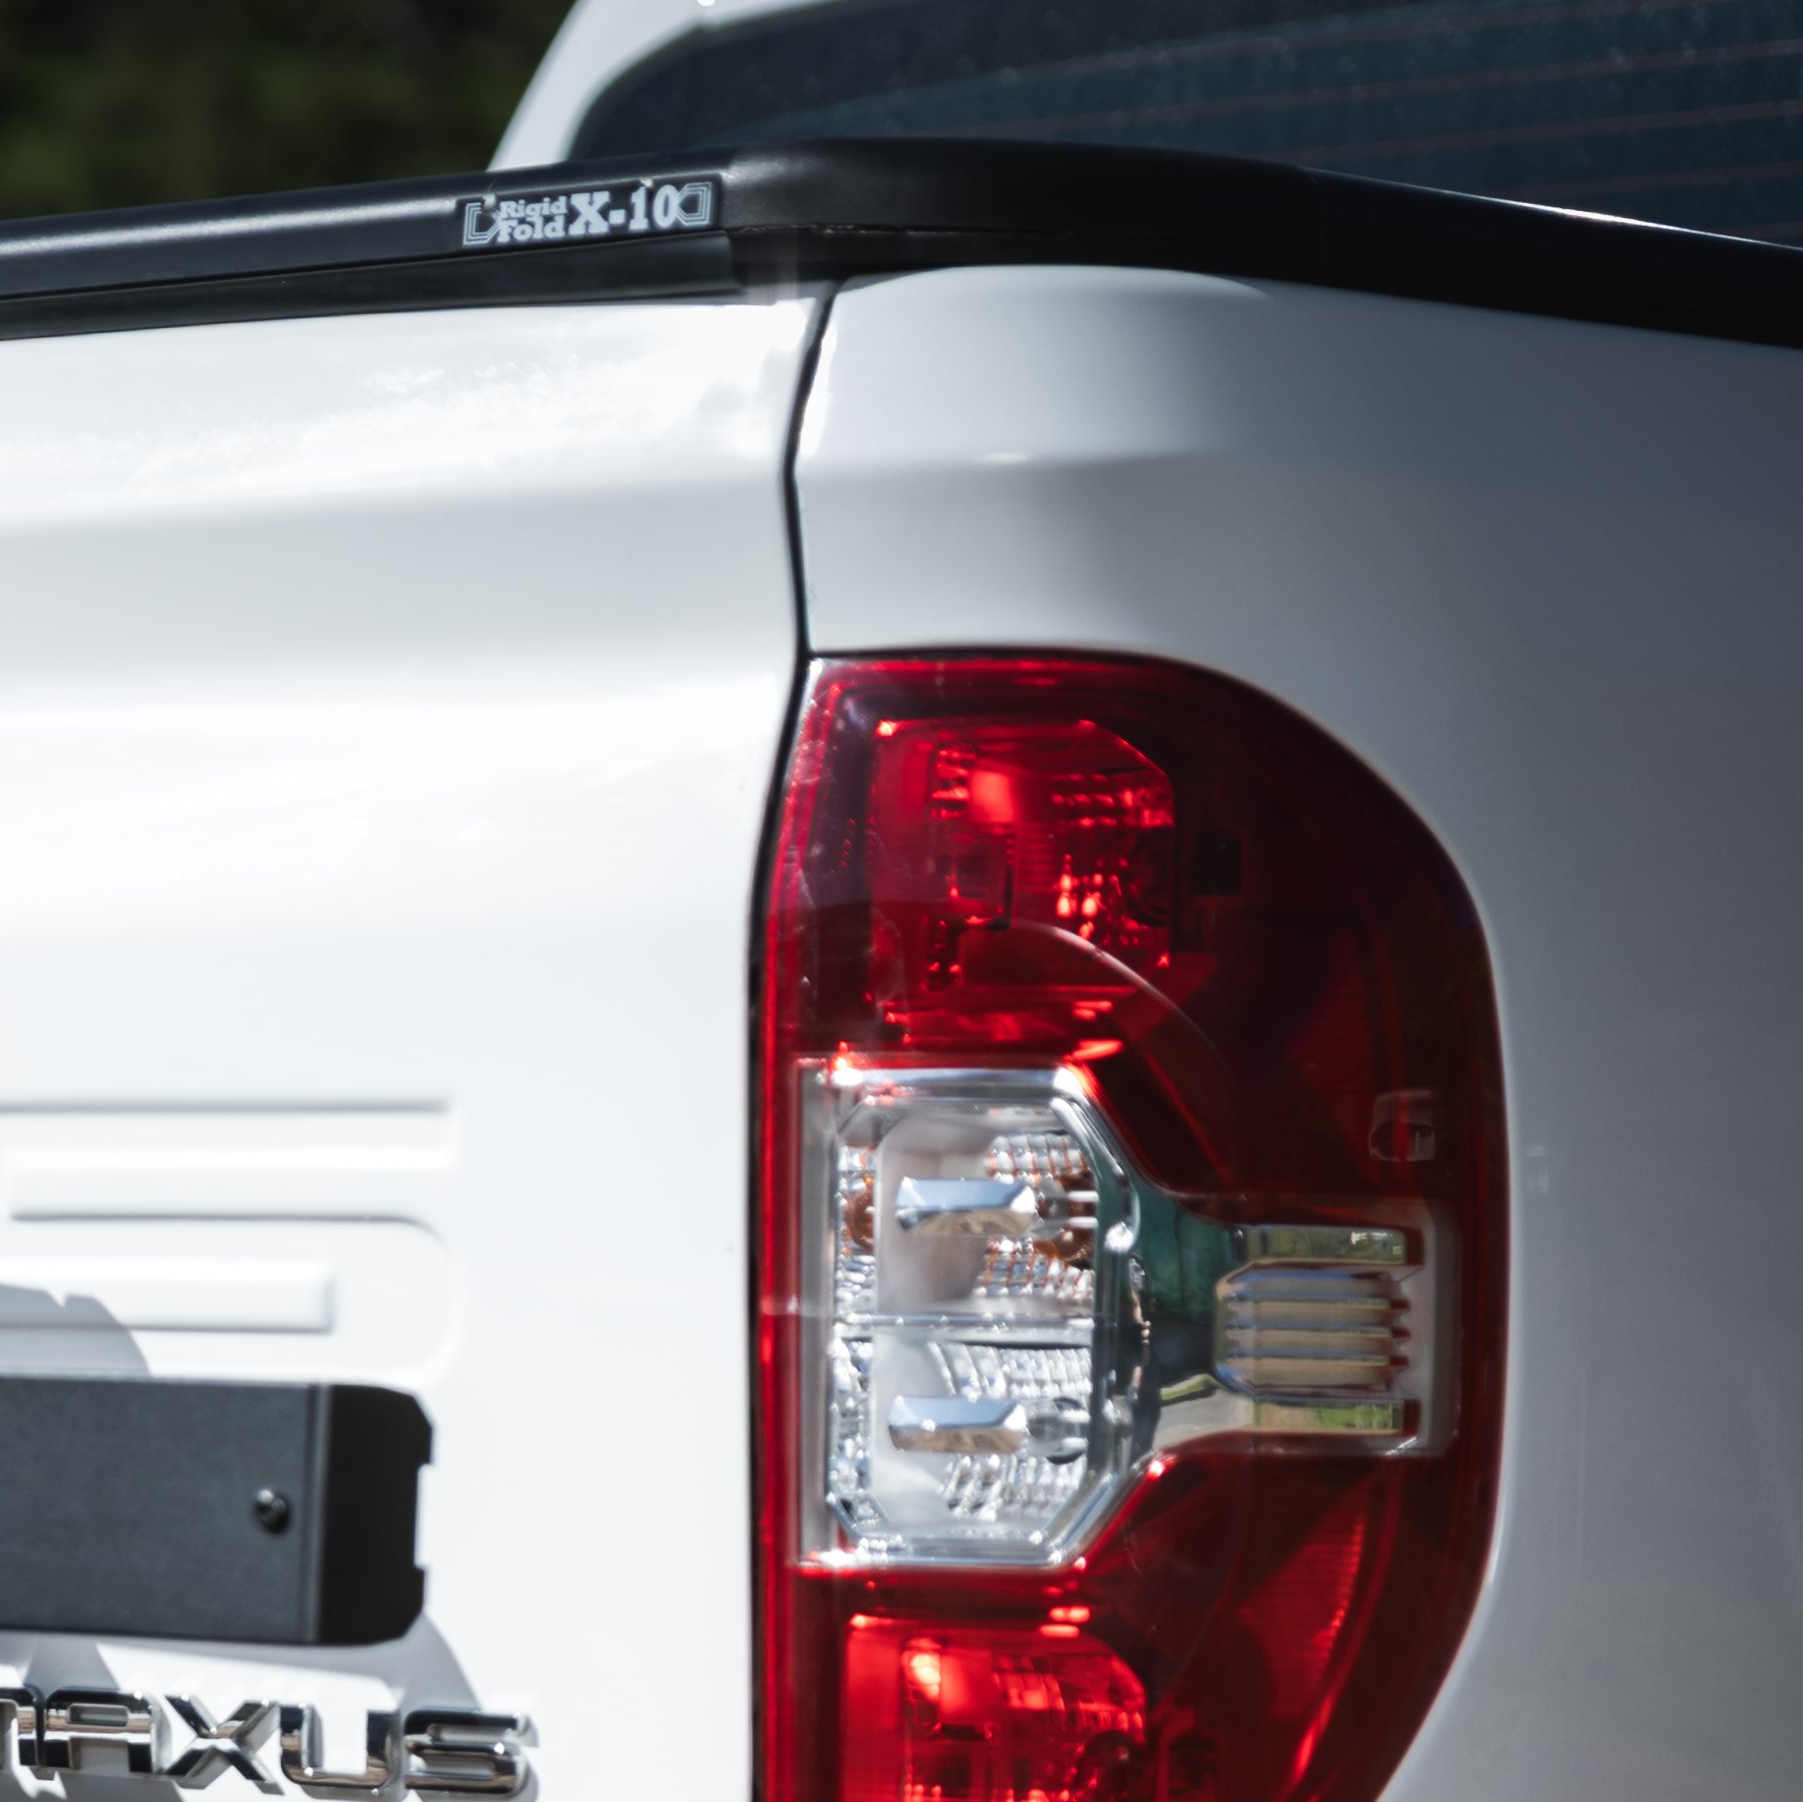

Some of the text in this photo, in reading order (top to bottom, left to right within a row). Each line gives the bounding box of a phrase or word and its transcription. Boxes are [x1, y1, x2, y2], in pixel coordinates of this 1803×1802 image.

[500, 196, 568, 220] Rigid
[568, 184, 678, 235] X-10
[497, 217, 567, 242] Fold
